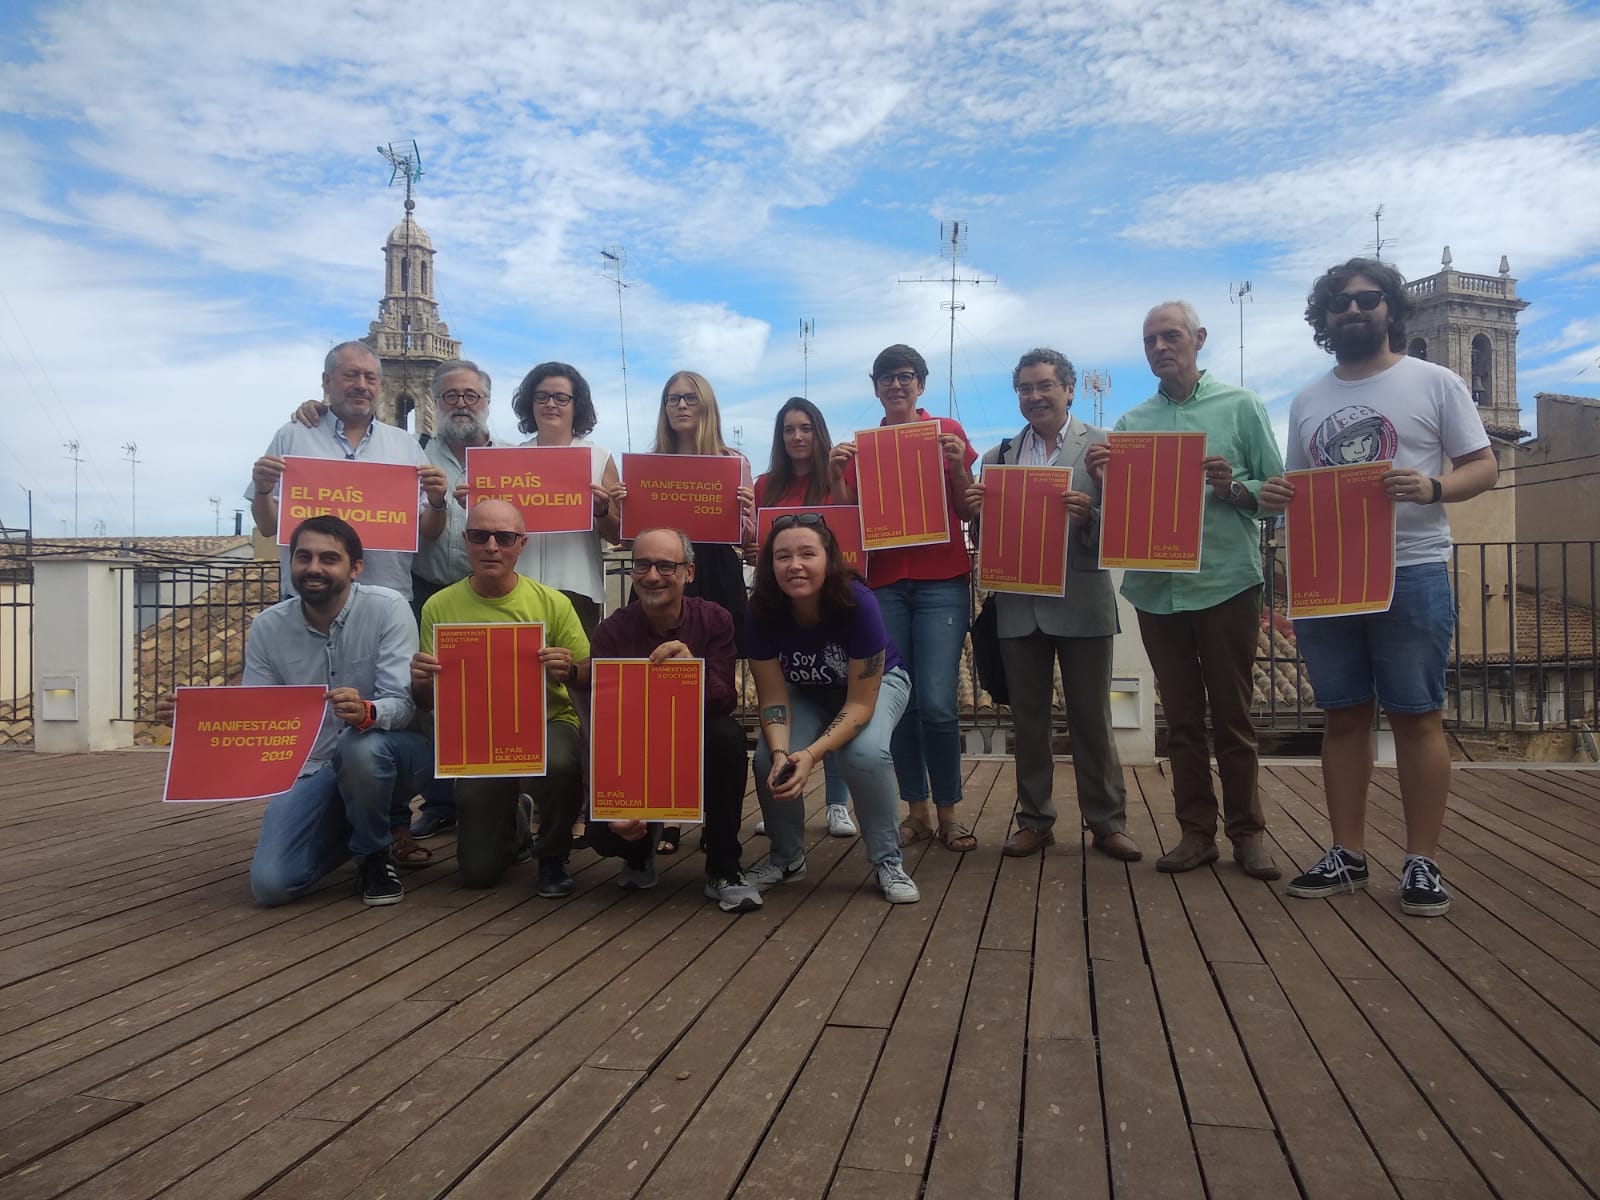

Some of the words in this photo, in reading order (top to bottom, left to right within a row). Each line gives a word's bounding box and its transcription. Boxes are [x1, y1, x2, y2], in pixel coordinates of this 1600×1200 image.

[475, 476, 496, 489] EL
[500, 471, 541, 489] PAÍS
[640, 479, 723, 492] MANIFESTACIÓ
[291, 486, 313, 500] EL
[318, 485, 364, 503] PAÍS
[518, 493, 583, 507] VOLEM
[651, 491, 658, 501] 9
[661, 492, 723, 503] D'OCTUBRE
[290, 504, 332, 519] QUE
[337, 507, 408, 524] VOLEM
[694, 505, 723, 516] 2019
[792, 651, 817, 667] SOY
[789, 665, 833, 684] ODAS
[198, 716, 301, 732] MANIFESTACIÓ
[210, 736, 219, 747] 9
[222, 735, 298, 748] D'OCTUBRE
[260, 750, 294, 762] 2019
[505, 745, 523, 754] PAÍS
[607, 789, 625, 798] PAÍS
[615, 799, 642, 807] VOLEM
